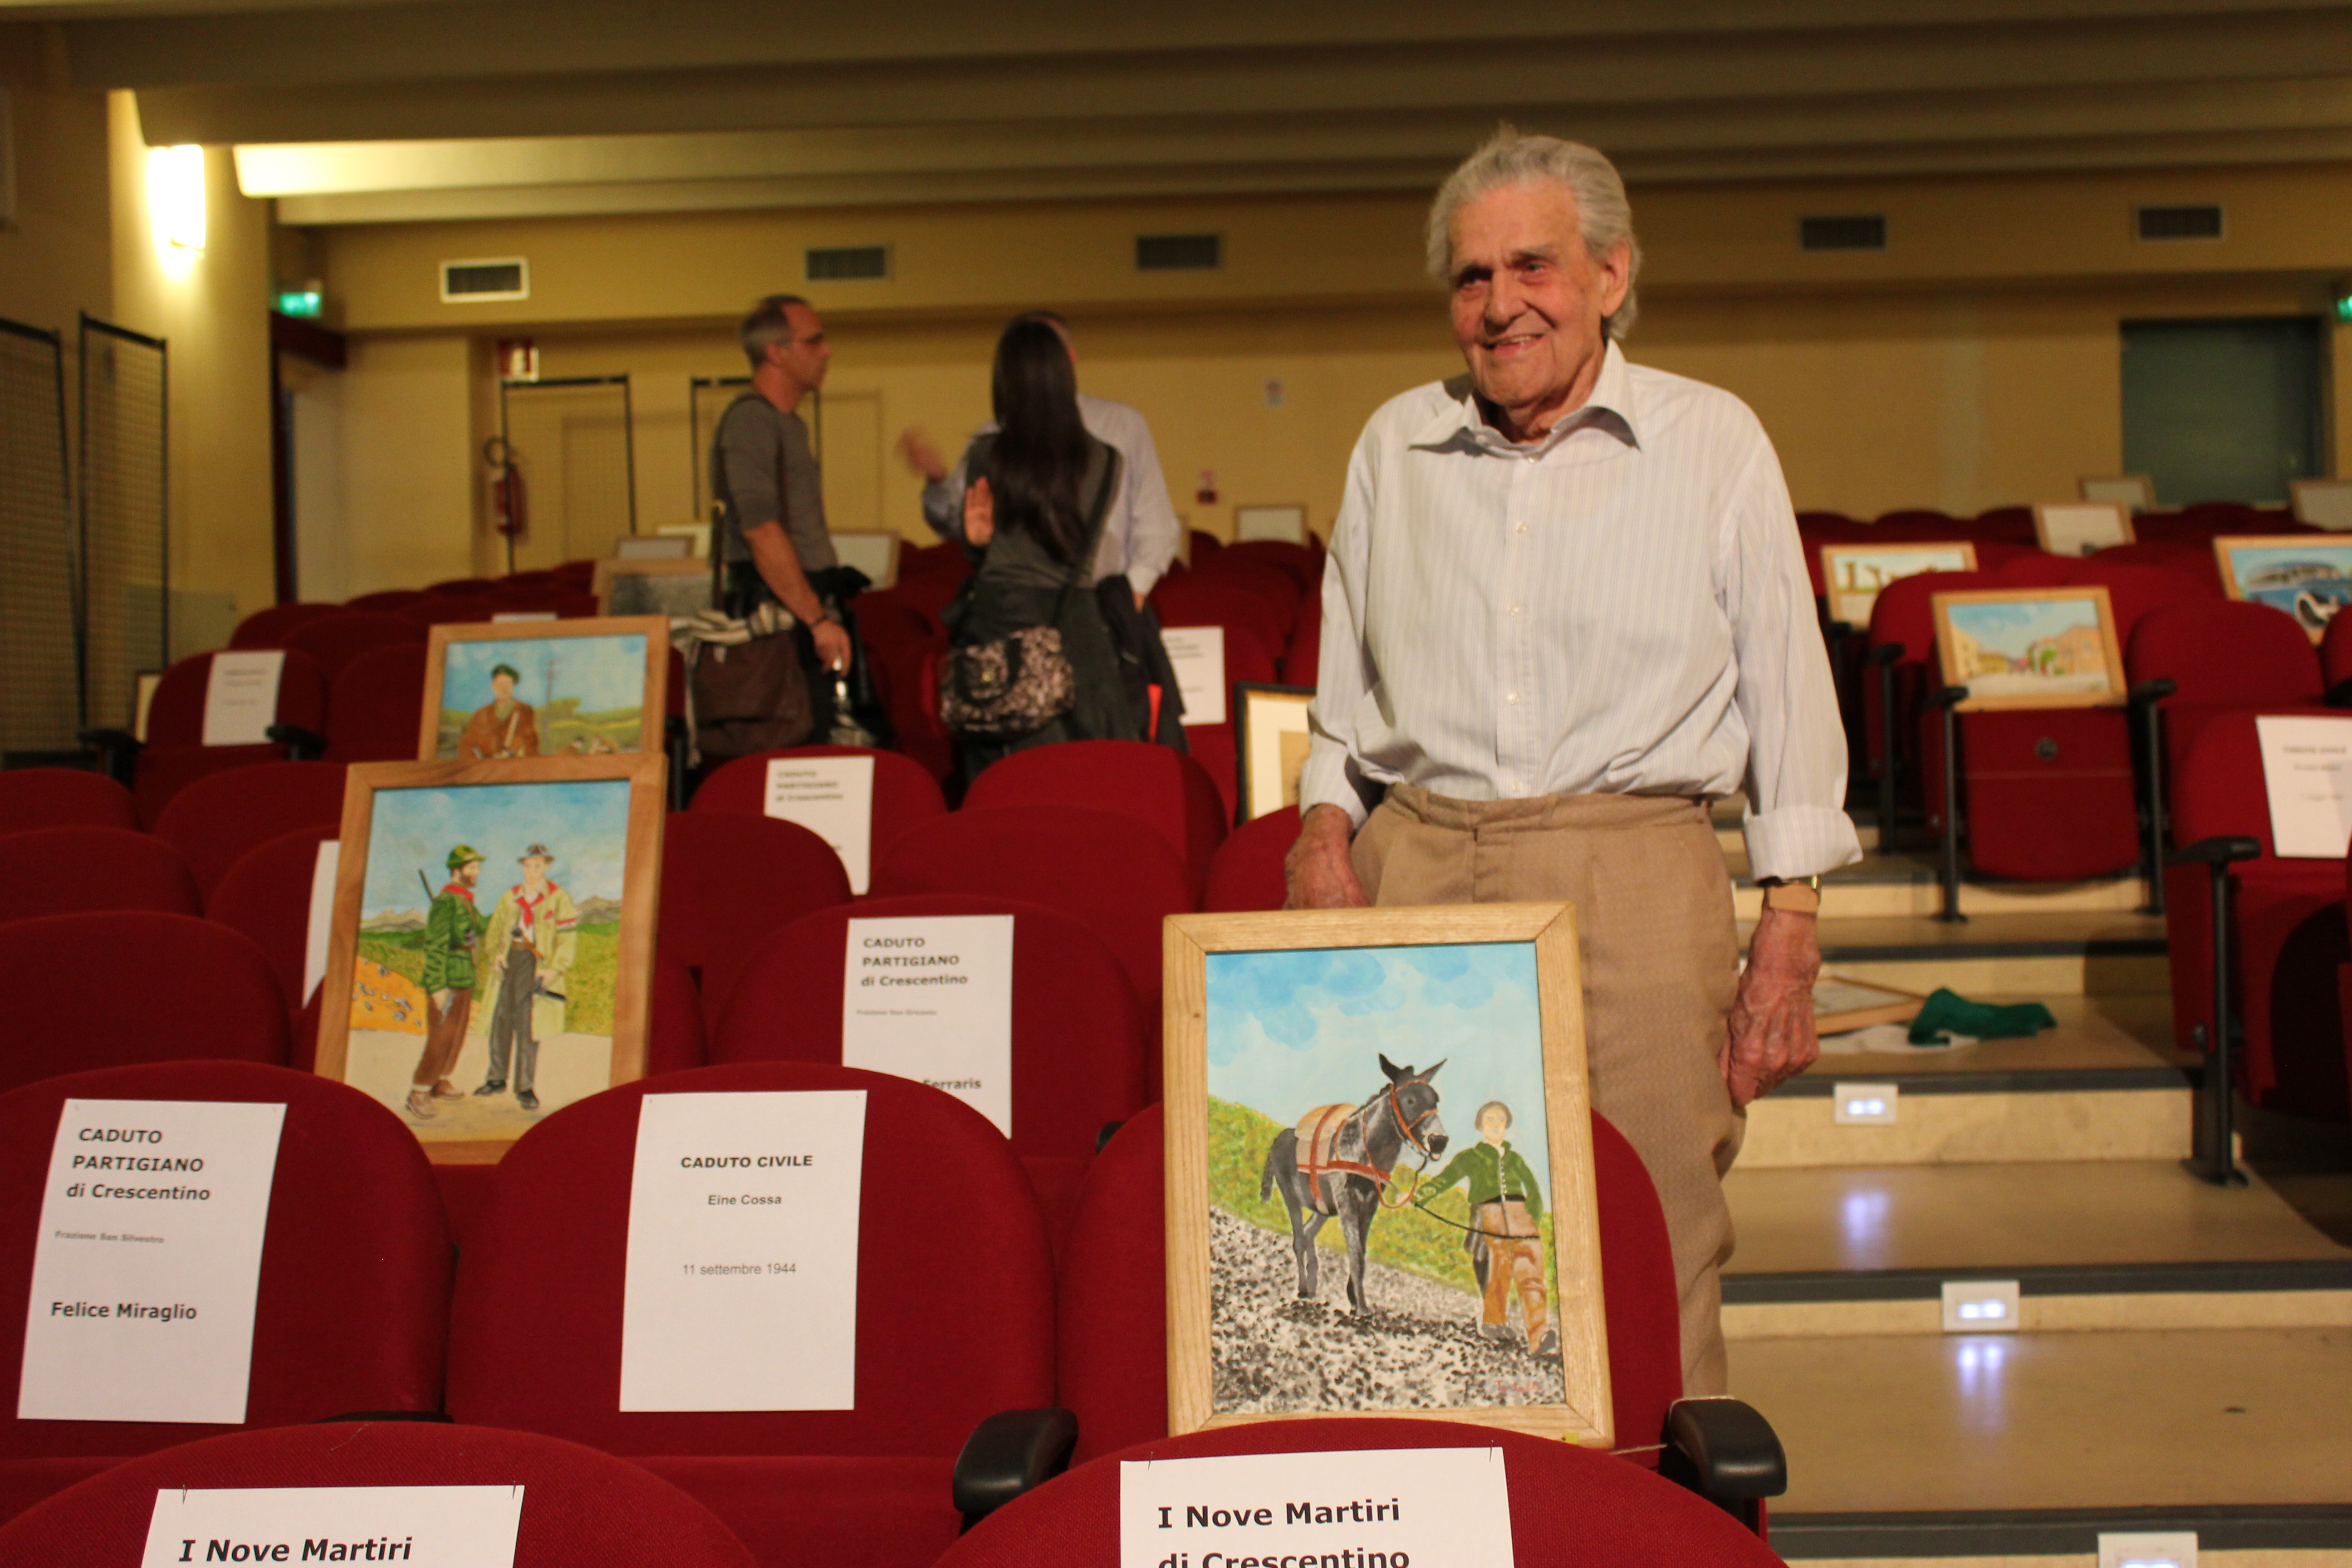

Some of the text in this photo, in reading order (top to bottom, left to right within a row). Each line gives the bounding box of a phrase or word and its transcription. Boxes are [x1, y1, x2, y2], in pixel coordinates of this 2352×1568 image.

[864, 938, 925, 948] CADUTO
[863, 956, 959, 966] PARTIGIANO
[862, 975, 967, 986] di Crescentino
[79, 1128, 162, 1143] CADUTO
[73, 1156, 203, 1171] PARTIGIANO
[681, 1156, 812, 1168] CADUTO CIVILE
[66, 1183, 210, 1200] di Crescentino
[709, 1195, 781, 1205] Eine Cossa
[683, 1264, 796, 1274] 11 settembre 1944
[52, 1302, 196, 1322] Felice Miraglio
[1158, 1498, 1399, 1528] I Nove Martiri
[179, 1537, 412, 1562] I Nove Martiri
[1159, 1548, 1409, 1568] di Crescentino
